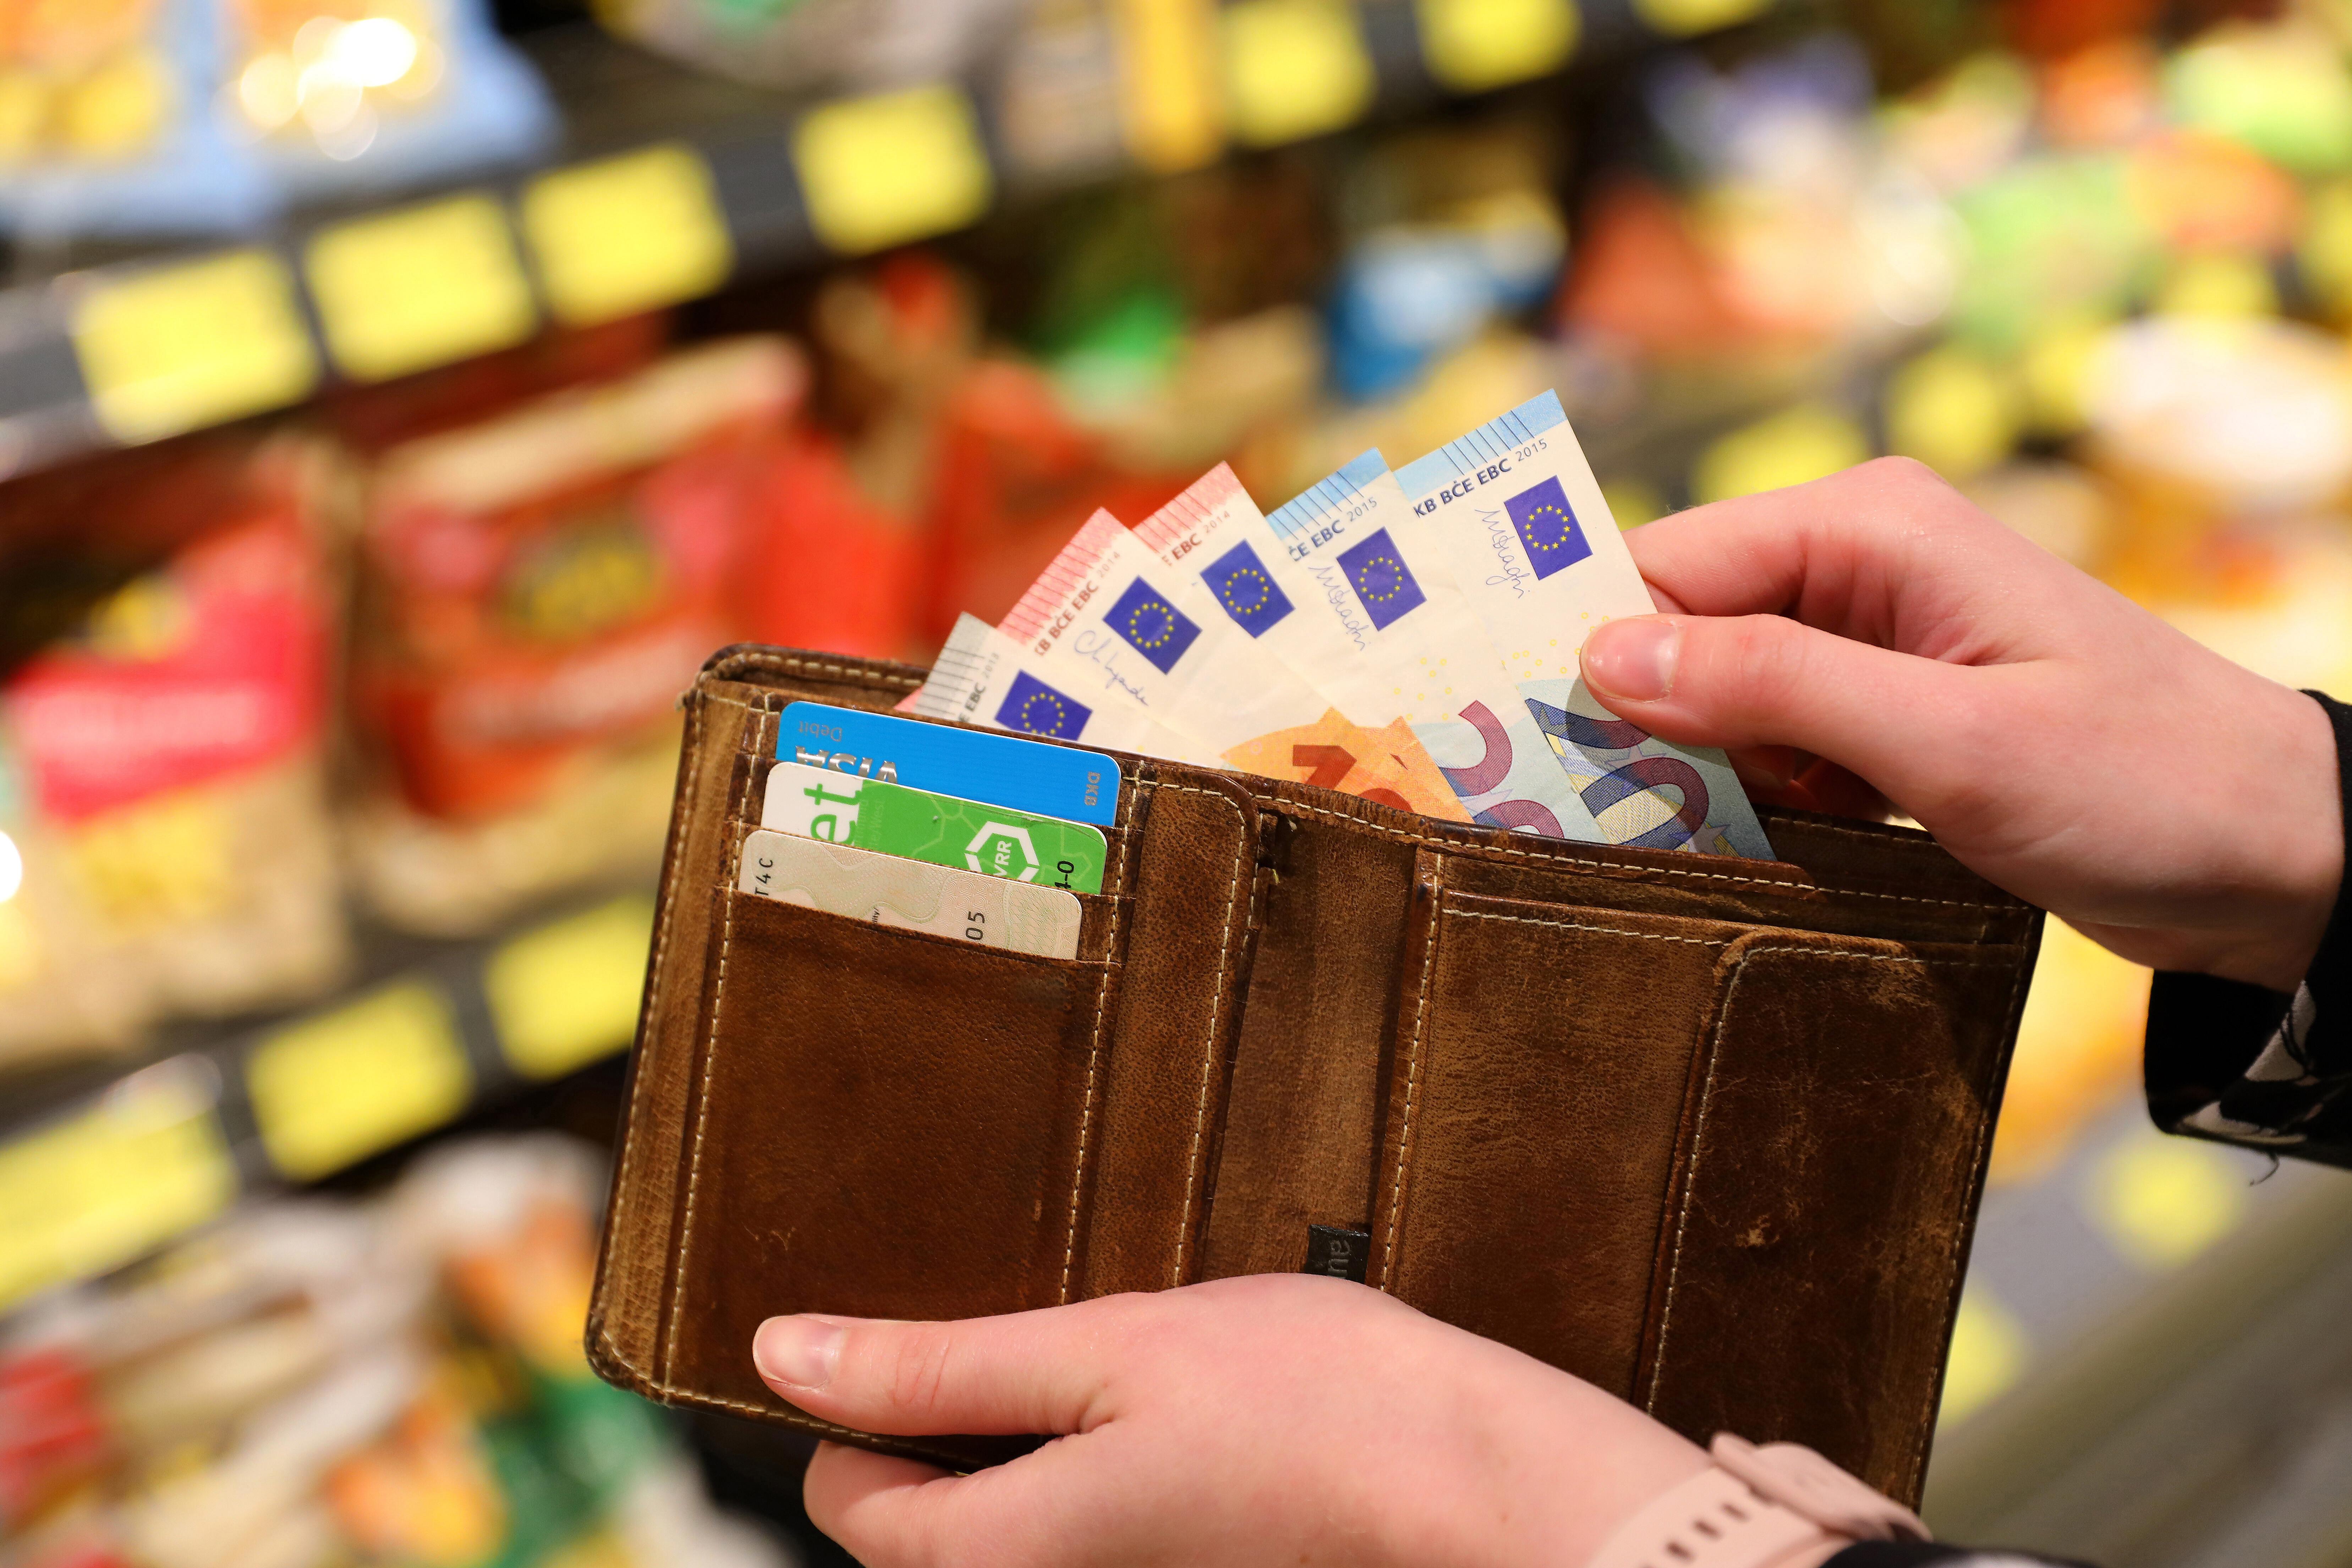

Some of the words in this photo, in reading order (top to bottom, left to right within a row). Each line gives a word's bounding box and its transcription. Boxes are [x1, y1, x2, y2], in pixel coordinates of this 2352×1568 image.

[1476, 459, 1512, 485] EBC
[1515, 438, 1547, 461] 2015
[1172, 533, 1202, 560] EBC
[1204, 511, 1230, 534] 2014
[1311, 520, 1345, 548] EBC
[1347, 497, 1377, 522] 2015
[1071, 580, 1099, 611] EBC
[1097, 552, 1120, 578] 2014
[799, 721, 843, 742] Debit
[1085, 771, 1101, 806] DKB
[993, 840, 1012, 877] VRR
[966, 911, 985, 940] 05
